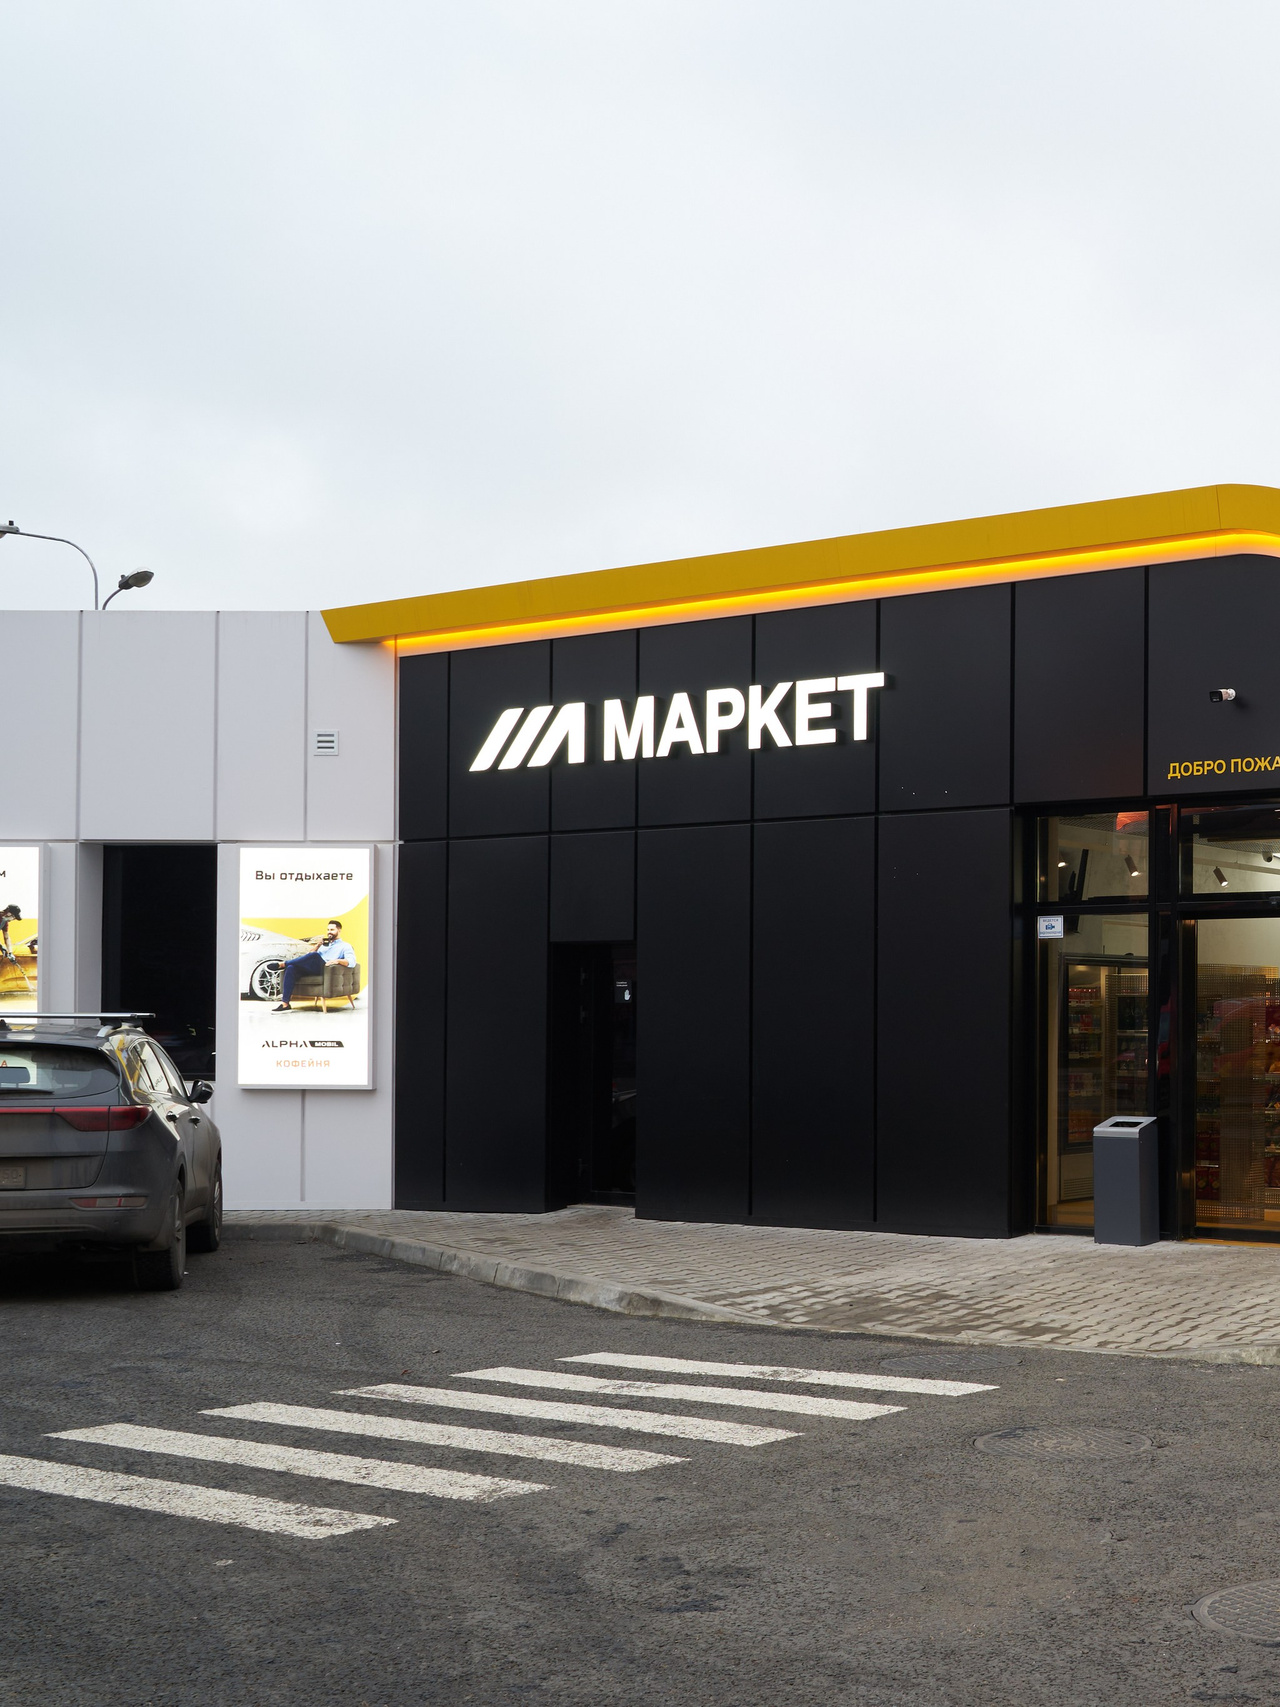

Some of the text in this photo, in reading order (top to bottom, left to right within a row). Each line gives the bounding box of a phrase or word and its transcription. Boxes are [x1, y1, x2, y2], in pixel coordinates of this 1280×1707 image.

[603, 671, 885, 762] МАРКЕТ
[1167, 759, 1226, 779] ДОБРО
[255, 870, 353, 882] Вы отдыхаете
[261, 1040, 308, 1048] ALPHA
[276, 1058, 331, 1068] КОФЕЙНЯ
